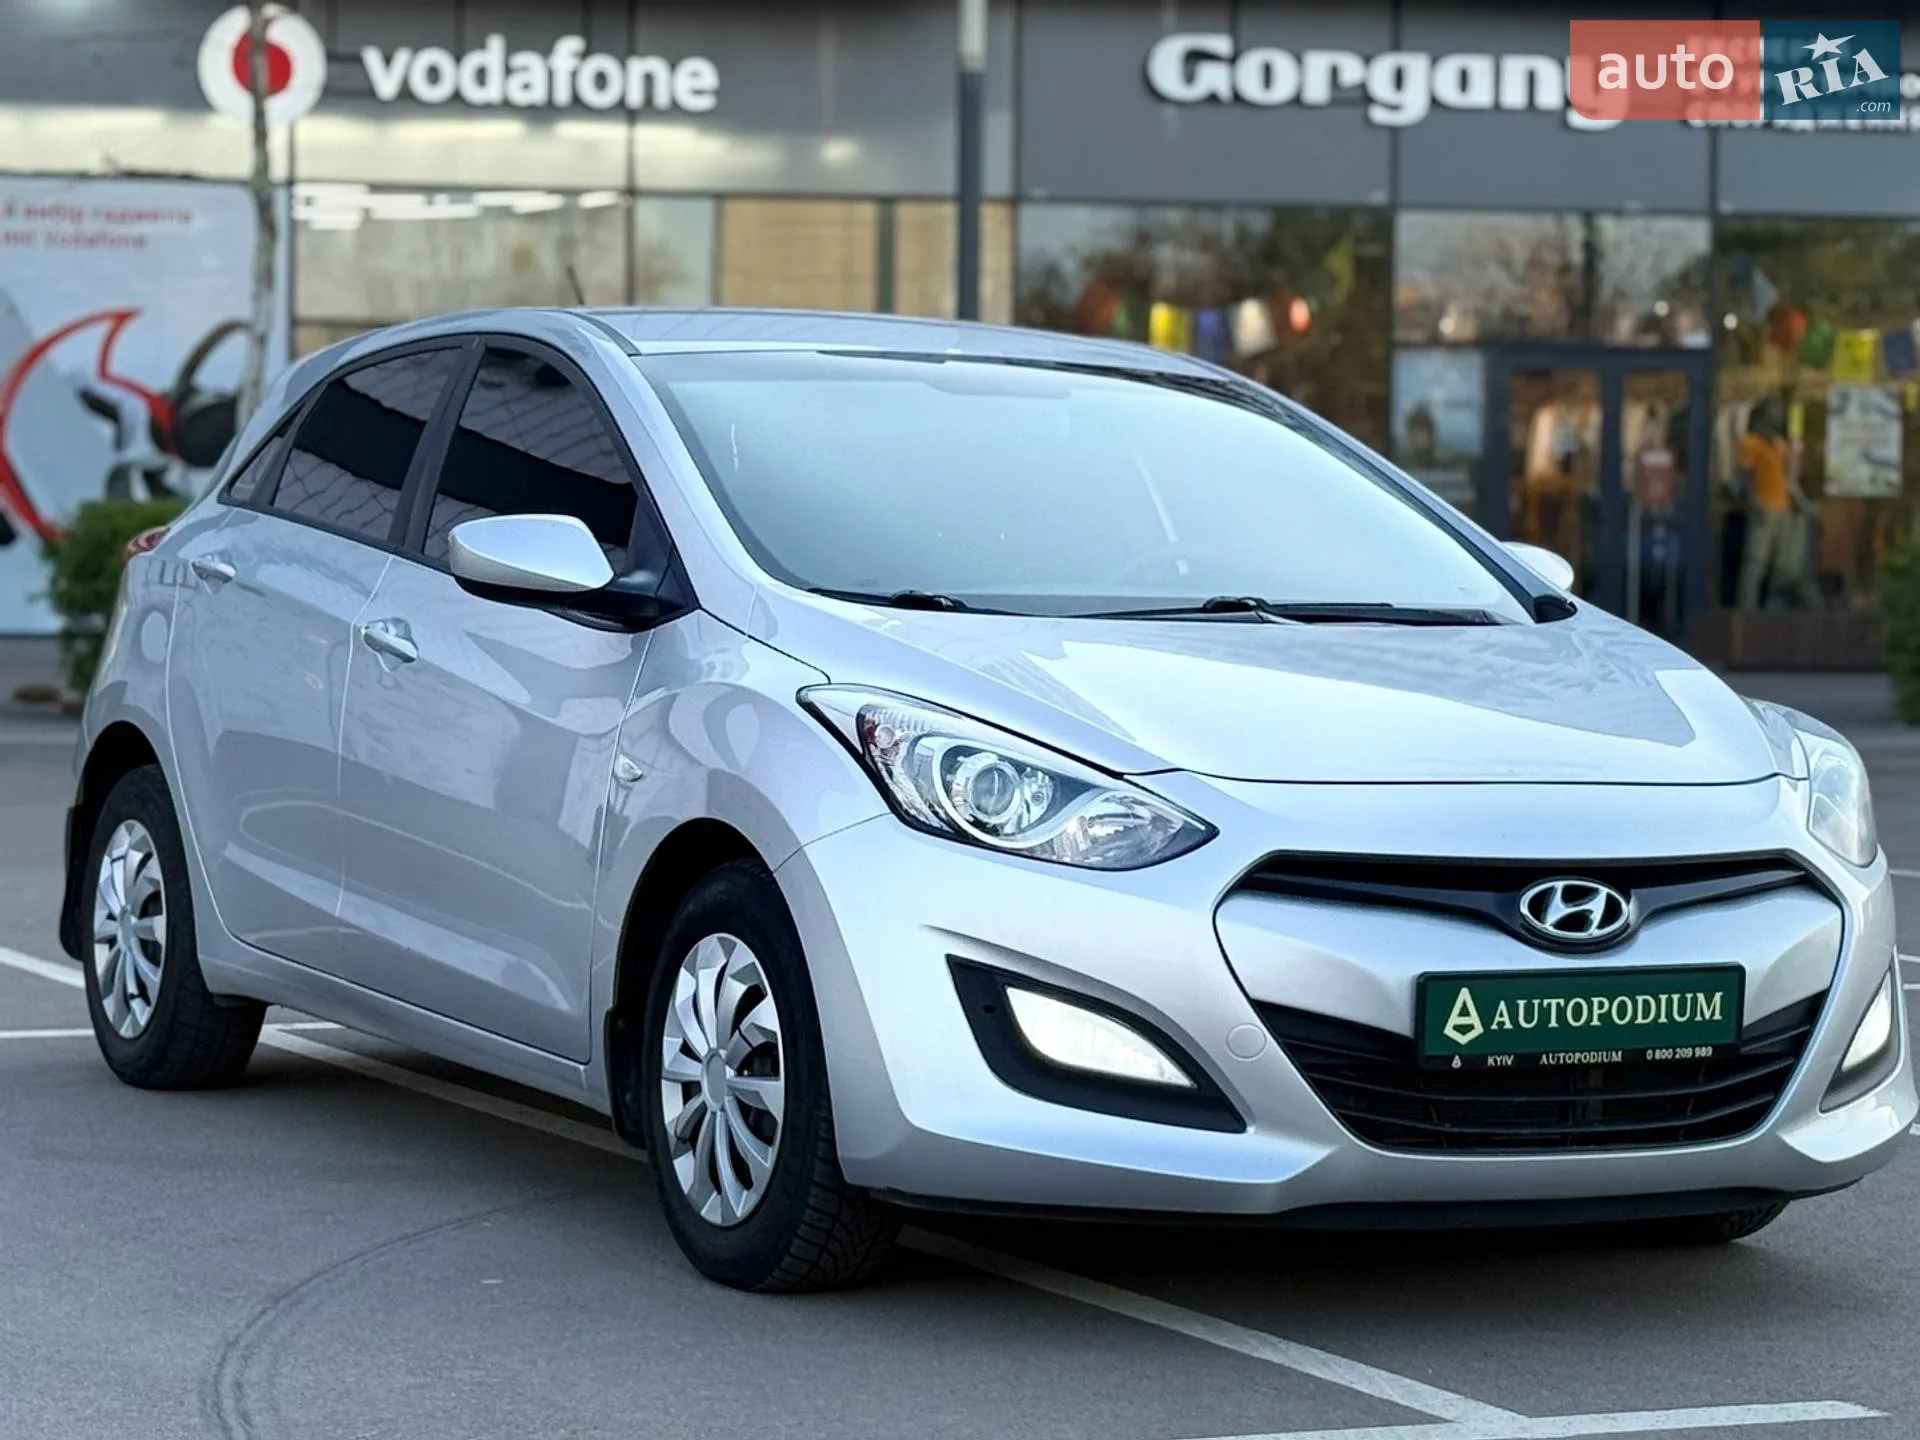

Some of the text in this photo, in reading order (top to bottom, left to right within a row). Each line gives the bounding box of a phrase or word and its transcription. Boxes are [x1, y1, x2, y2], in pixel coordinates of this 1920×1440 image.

[361, 33, 719, 112] vodafone
[1490, 991, 1724, 1030] AUTOPODIUM
[1487, 1054, 1515, 1067] KYIV
[1539, 1049, 1623, 1065] AUTOPODIUM
